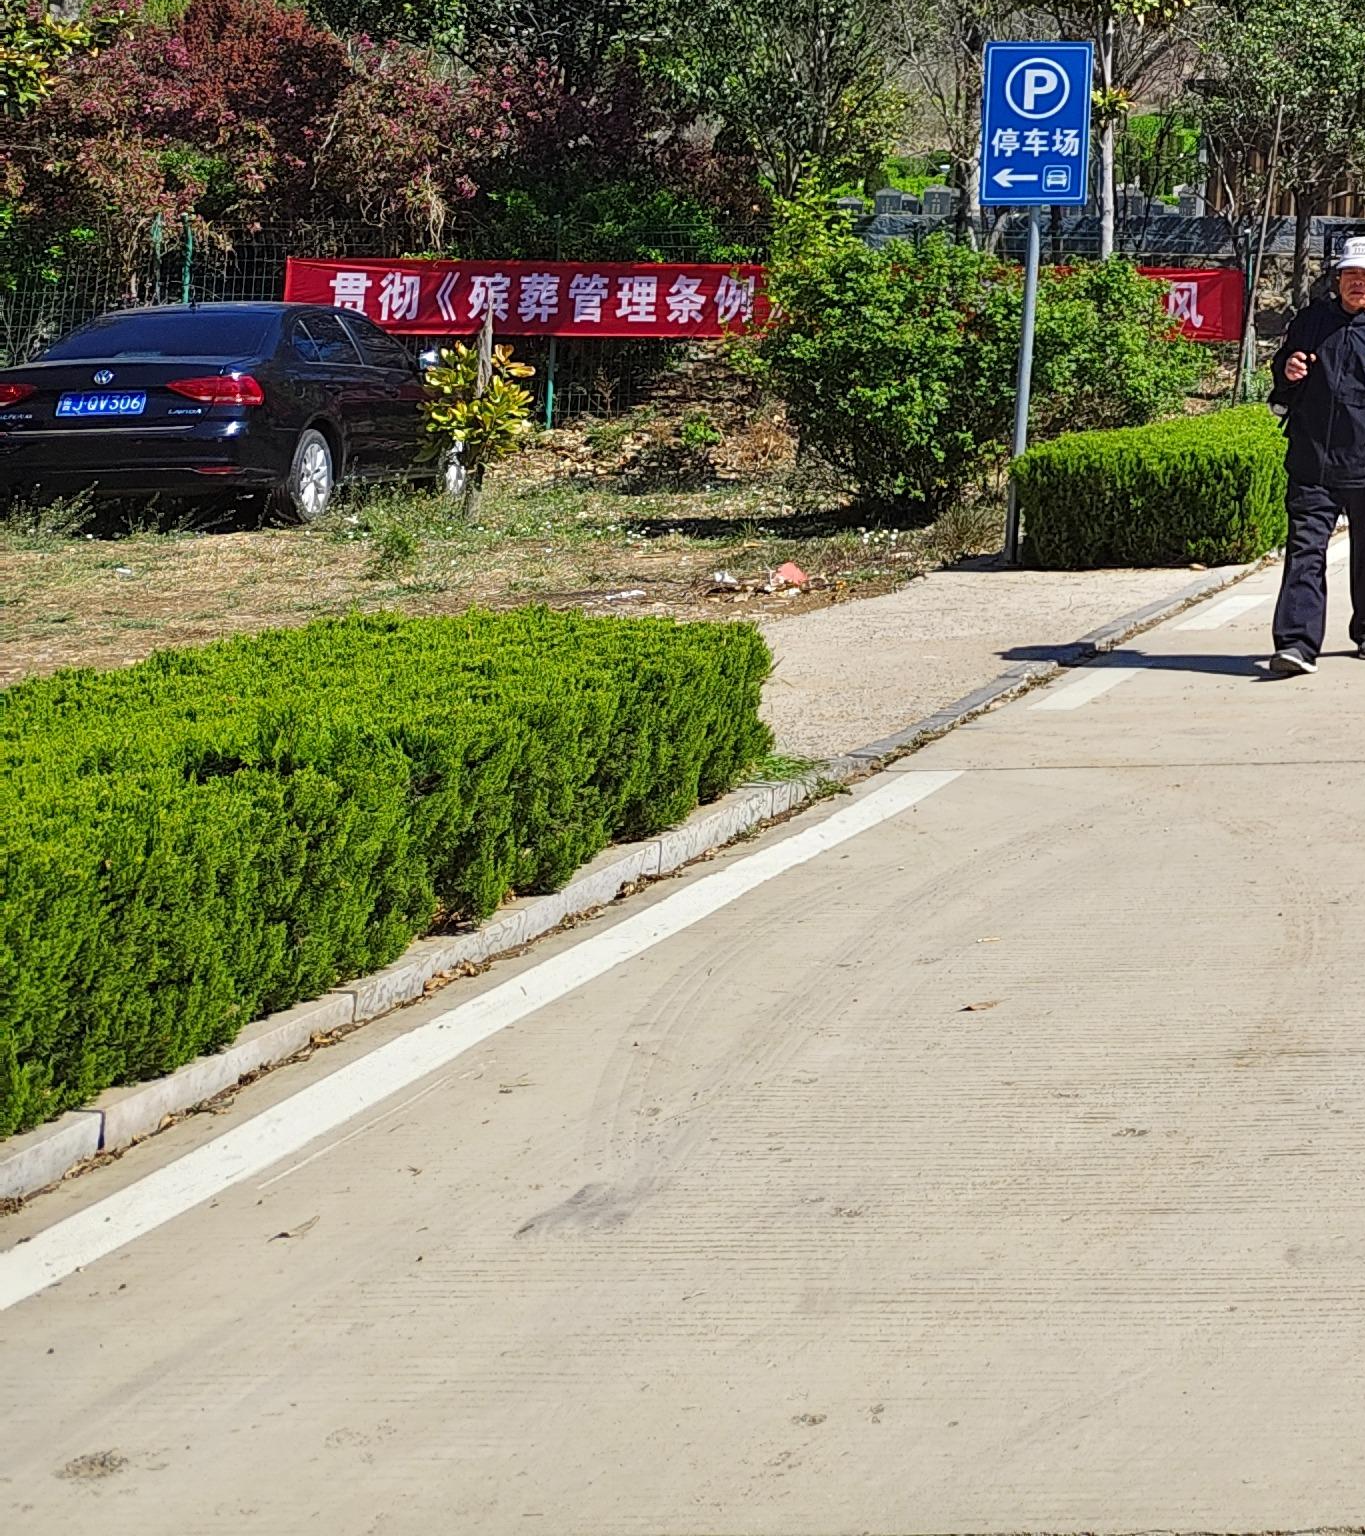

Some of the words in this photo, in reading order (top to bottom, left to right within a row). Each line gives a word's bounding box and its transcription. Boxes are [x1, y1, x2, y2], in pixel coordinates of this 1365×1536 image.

[1023, 69, 1058, 110] P
[991, 128, 1080, 157] 停车场
[329, 272, 783, 324] 贯彻《殡葬管理条例
[1168, 281, 1204, 328] 风
